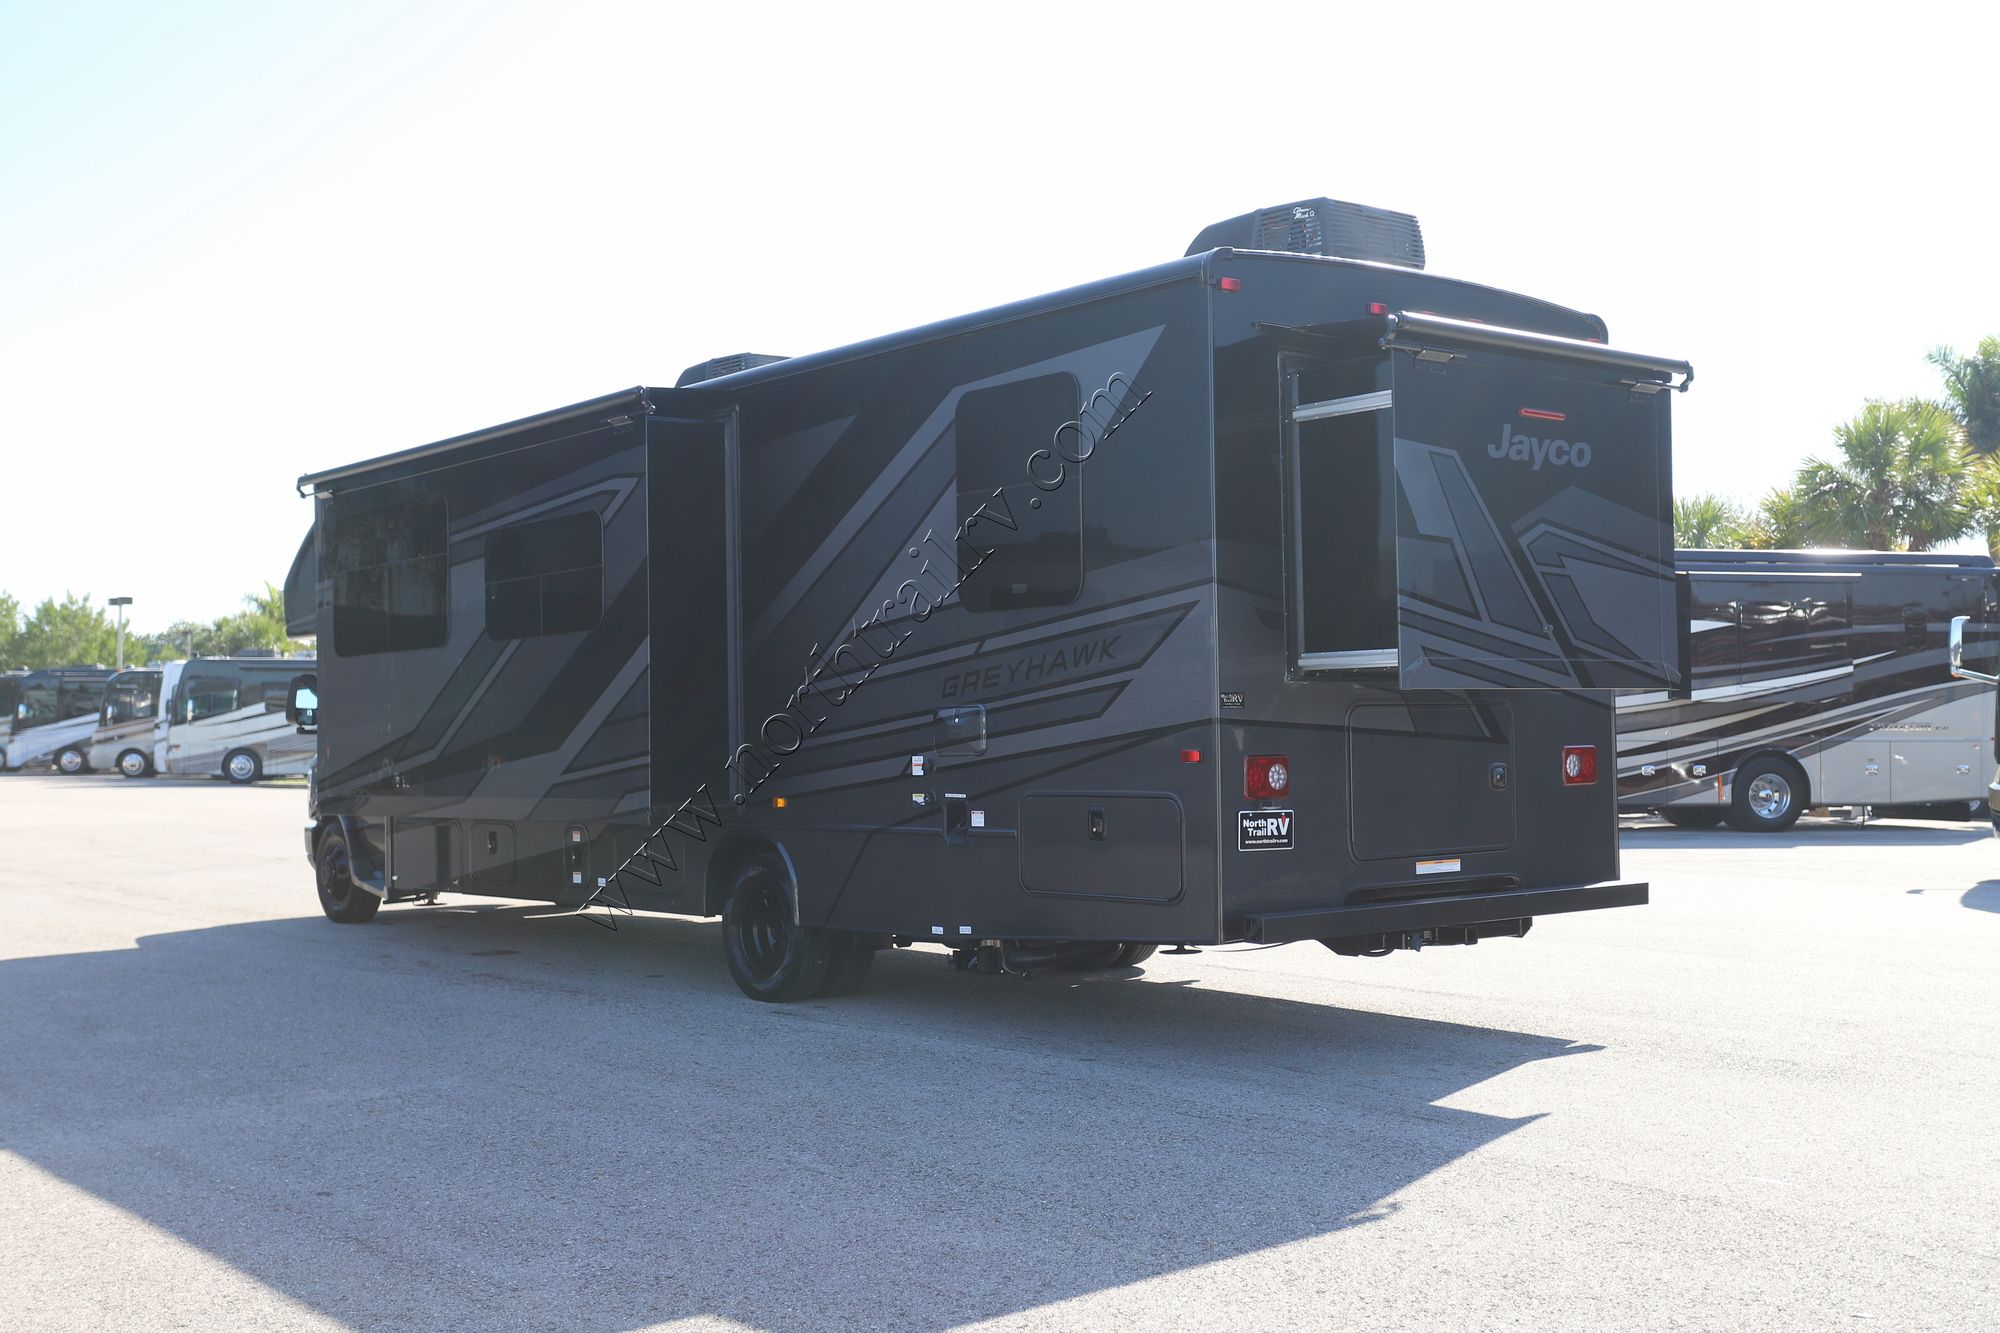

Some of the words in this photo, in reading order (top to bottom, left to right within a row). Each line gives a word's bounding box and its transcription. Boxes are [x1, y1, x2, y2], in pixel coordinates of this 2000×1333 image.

[1487, 423, 1592, 471] Jayco
[943, 635, 1121, 698] GREYHAWK
[1243, 819, 1267, 828] North
[1248, 828, 1267, 837] Trail
[1267, 817, 1290, 836] RV
